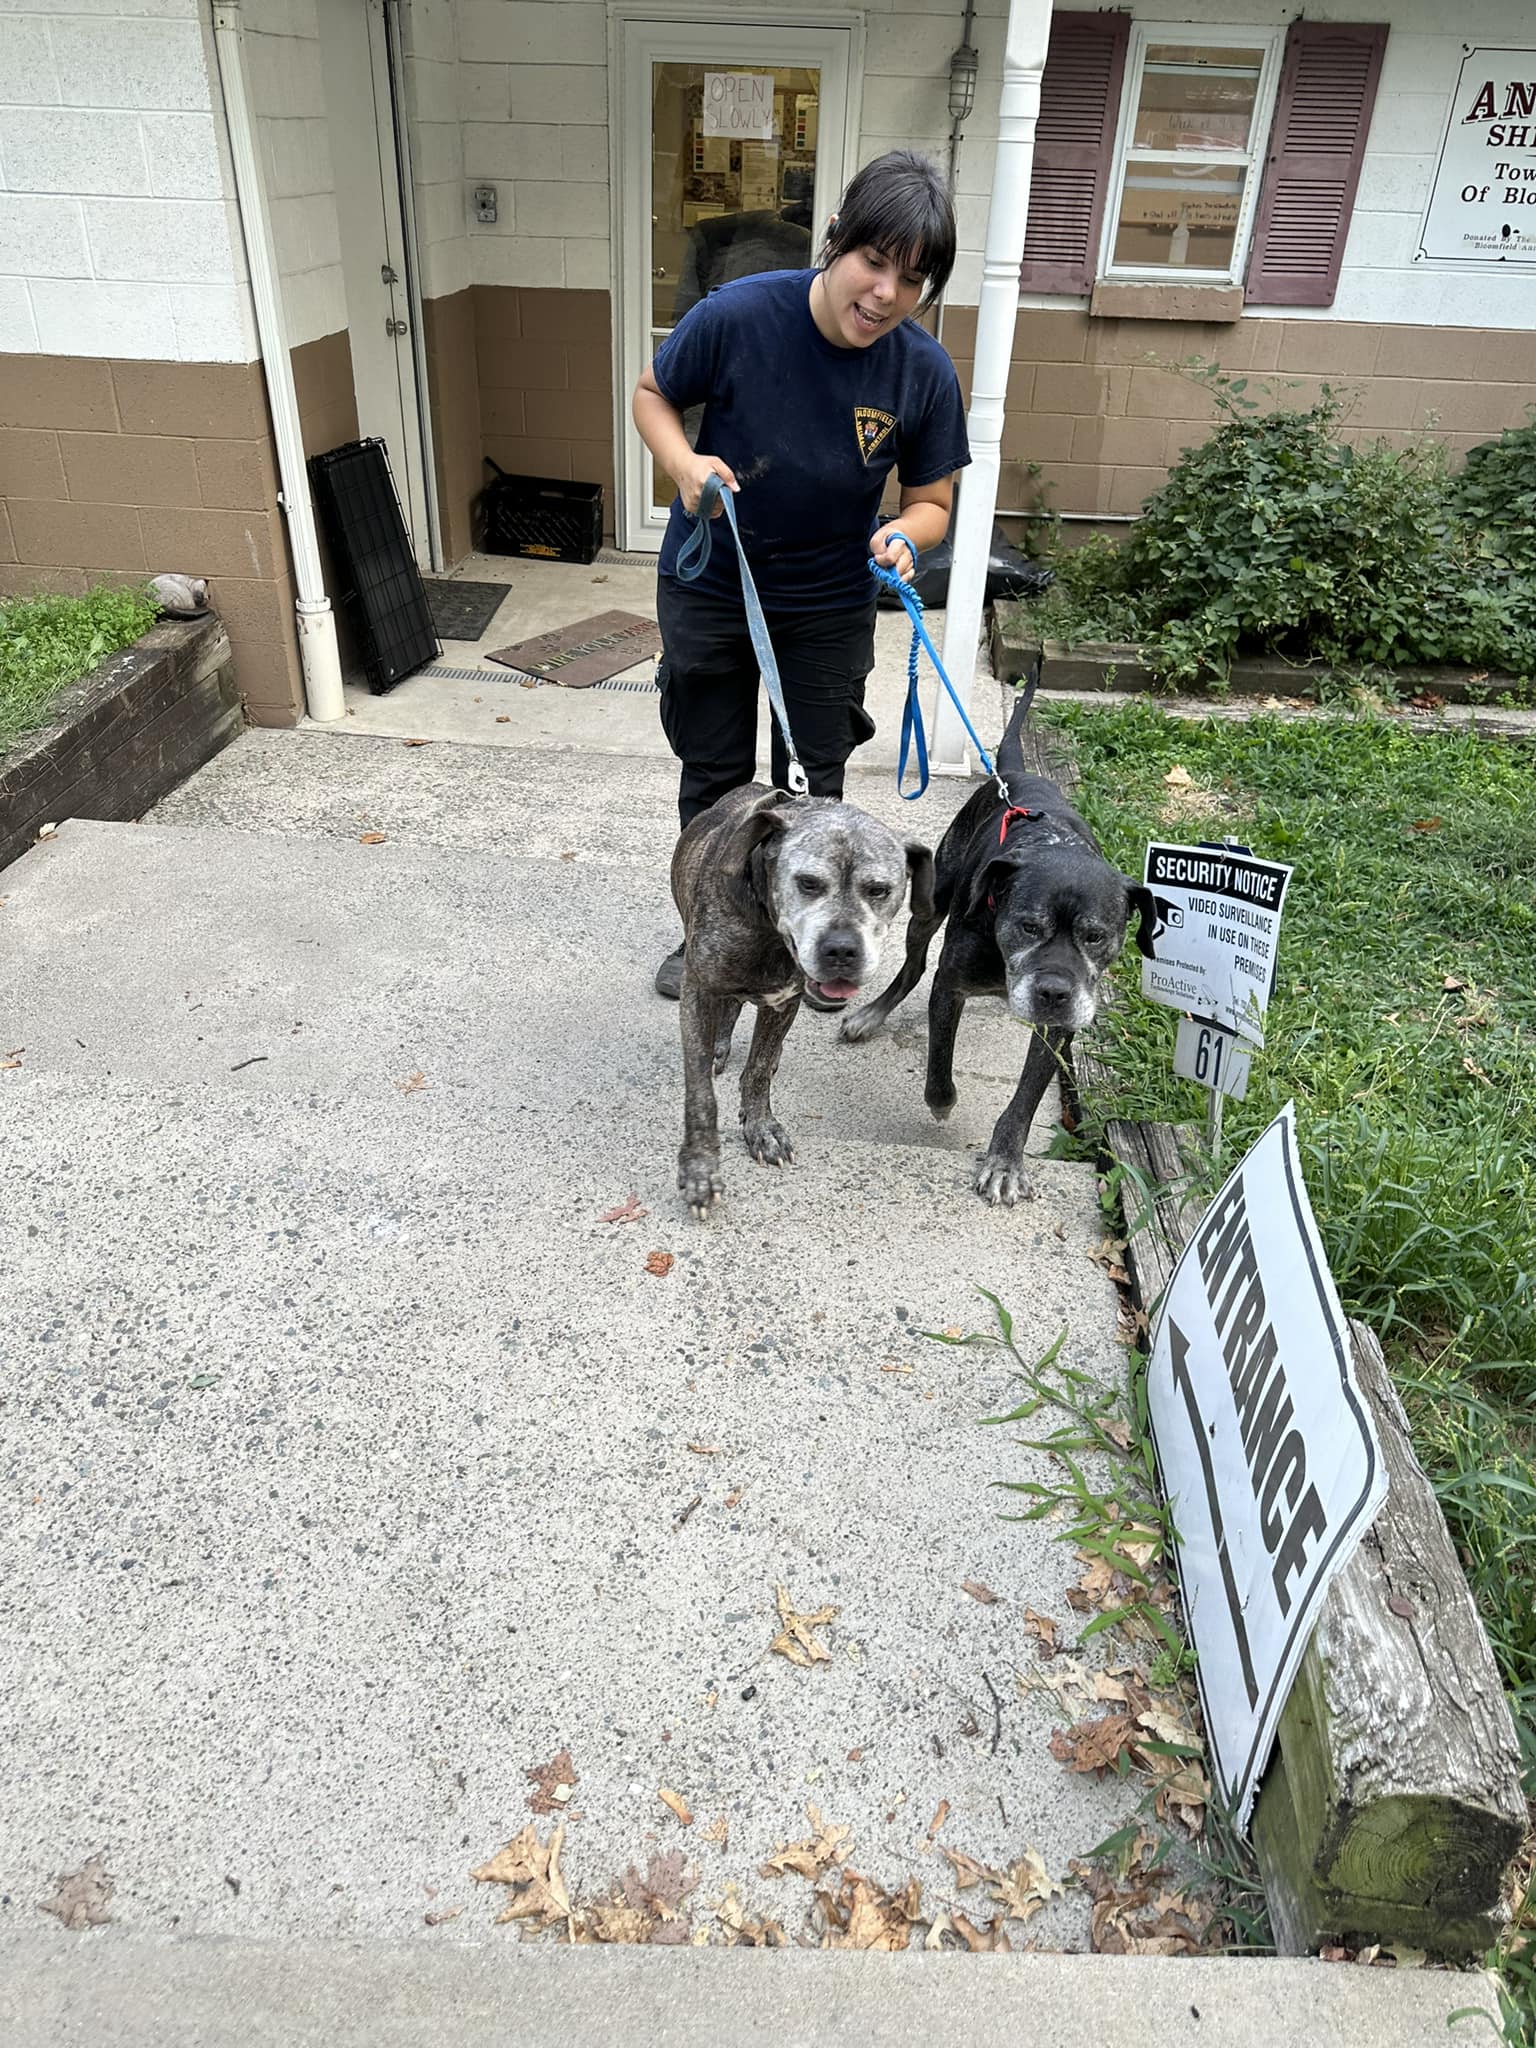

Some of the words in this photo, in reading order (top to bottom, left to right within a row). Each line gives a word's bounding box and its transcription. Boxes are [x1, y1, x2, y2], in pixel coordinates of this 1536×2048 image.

[711, 76, 765, 103] OPEN
[705, 104, 772, 129] SLOWLY
[1461, 185, 1490, 202] Of
[1463, 233, 1497, 241] Donated
[1474, 242, 1518, 250] Bloomfield
[857, 409, 893, 426] BLOOMFIELD
[1156, 856, 1232, 888] SECURITY
[1234, 868, 1278, 902] NOTICE
[1188, 897, 1217, 916] VIDEO
[1219, 903, 1273, 935] SURVEILLANCE
[1208, 924, 1219, 939] IN
[1219, 927, 1236, 945] USE
[1238, 932, 1249, 949] ON
[1250, 937, 1270, 959] THESE
[1176, 960, 1199, 973] Protected
[1234, 955, 1267, 984] PREMISES
[1151, 971, 1197, 995] ProActive
[1195, 1029, 1224, 1086] 61
[1197, 1171, 1328, 1620] ENTRANCE
